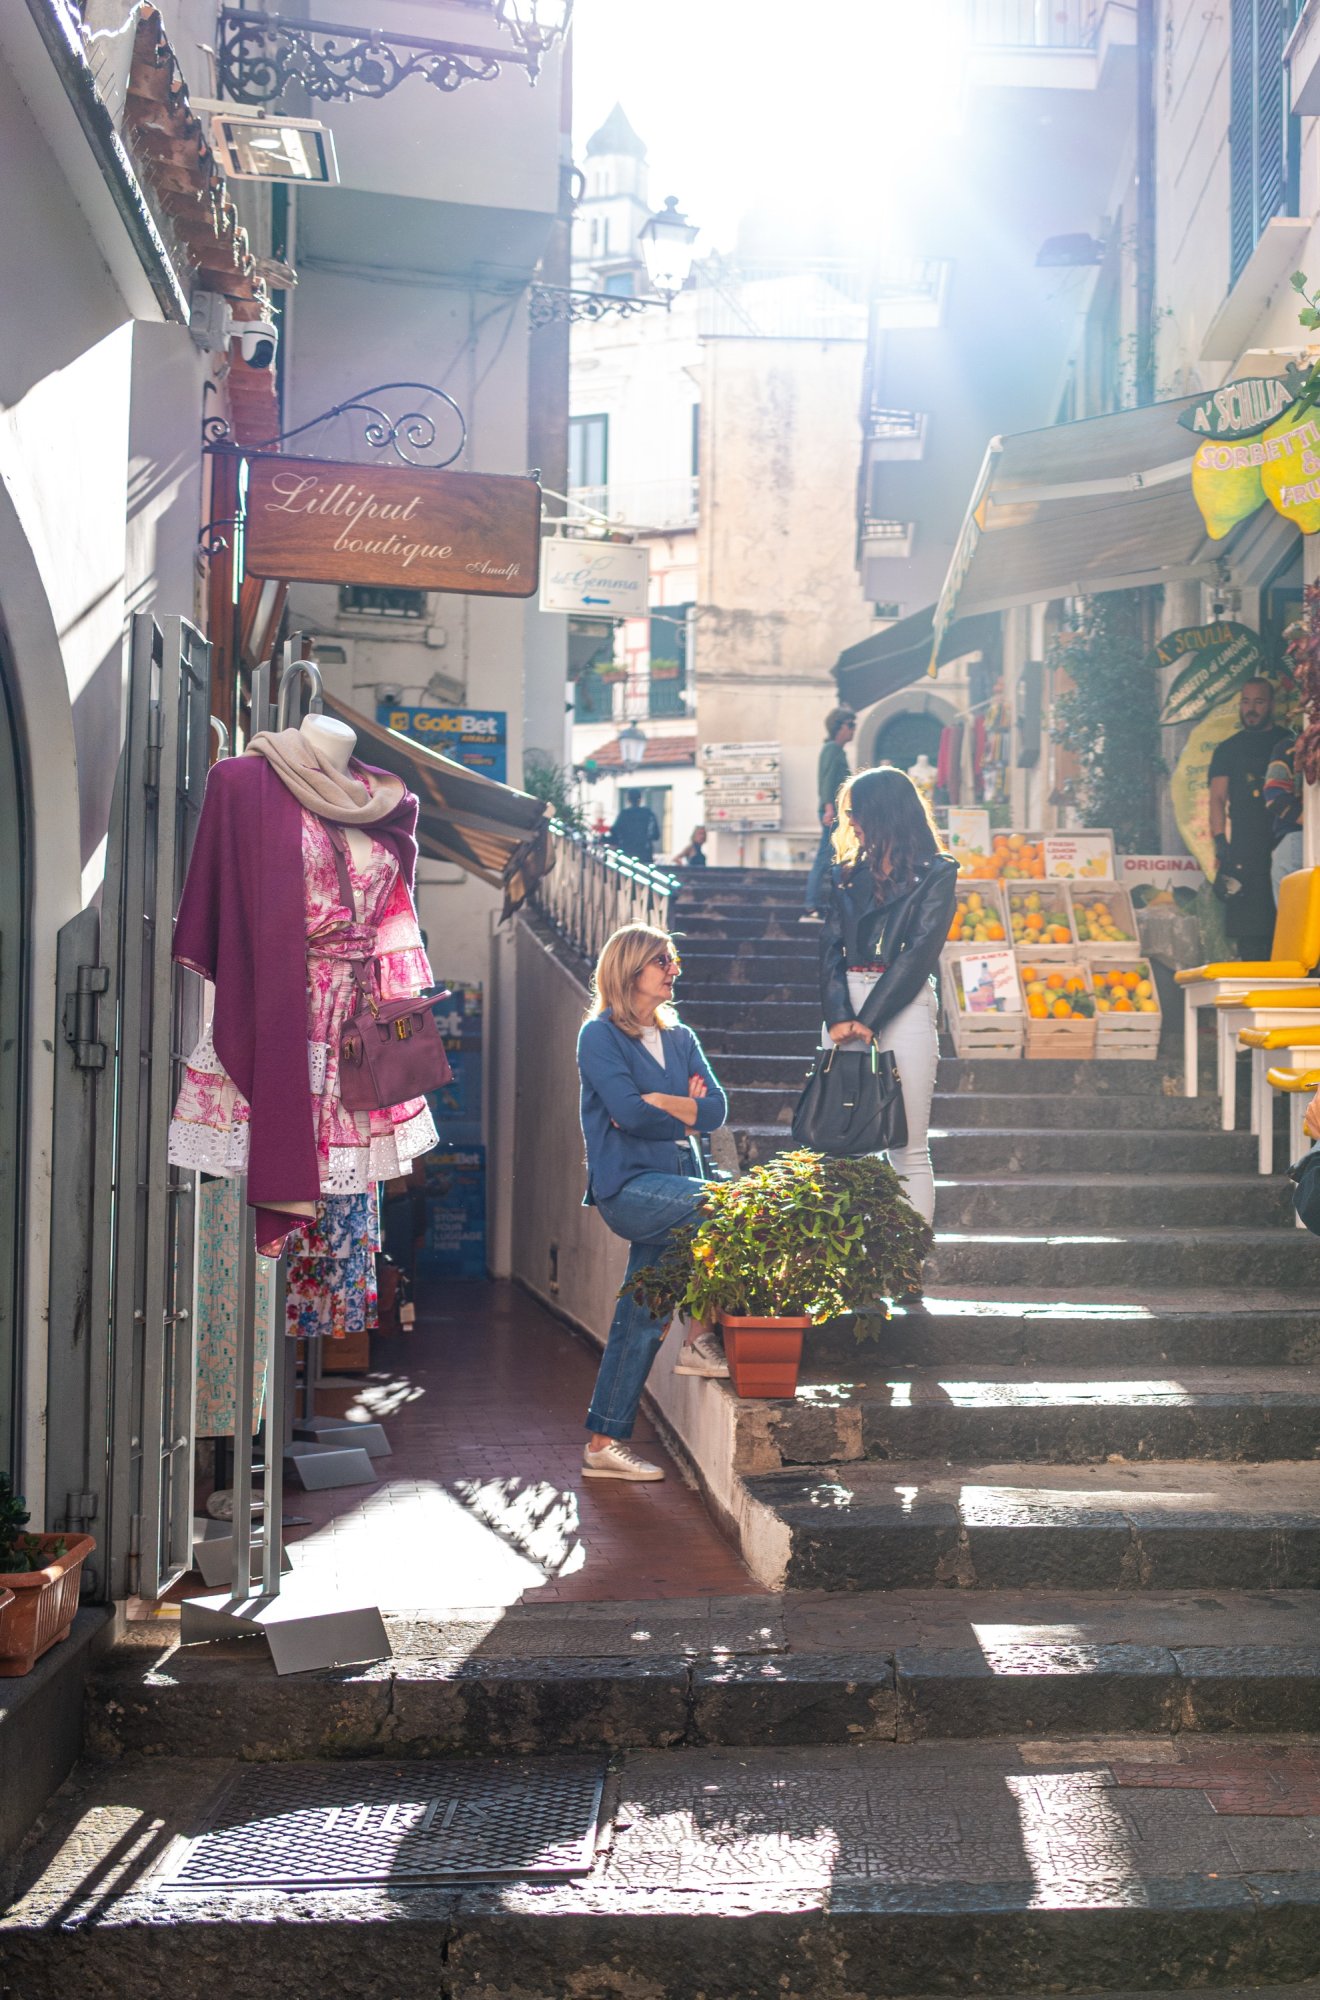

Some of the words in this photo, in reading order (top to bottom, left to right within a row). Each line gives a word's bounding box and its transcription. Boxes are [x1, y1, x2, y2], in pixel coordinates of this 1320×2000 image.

[1197, 420, 1320, 471] SORBETTI
[264, 472, 425, 538] Lilliput
[333, 526, 454, 568] boutique
[465, 559, 521, 581] Amalfi
[413, 711, 498, 734] GoldBet
